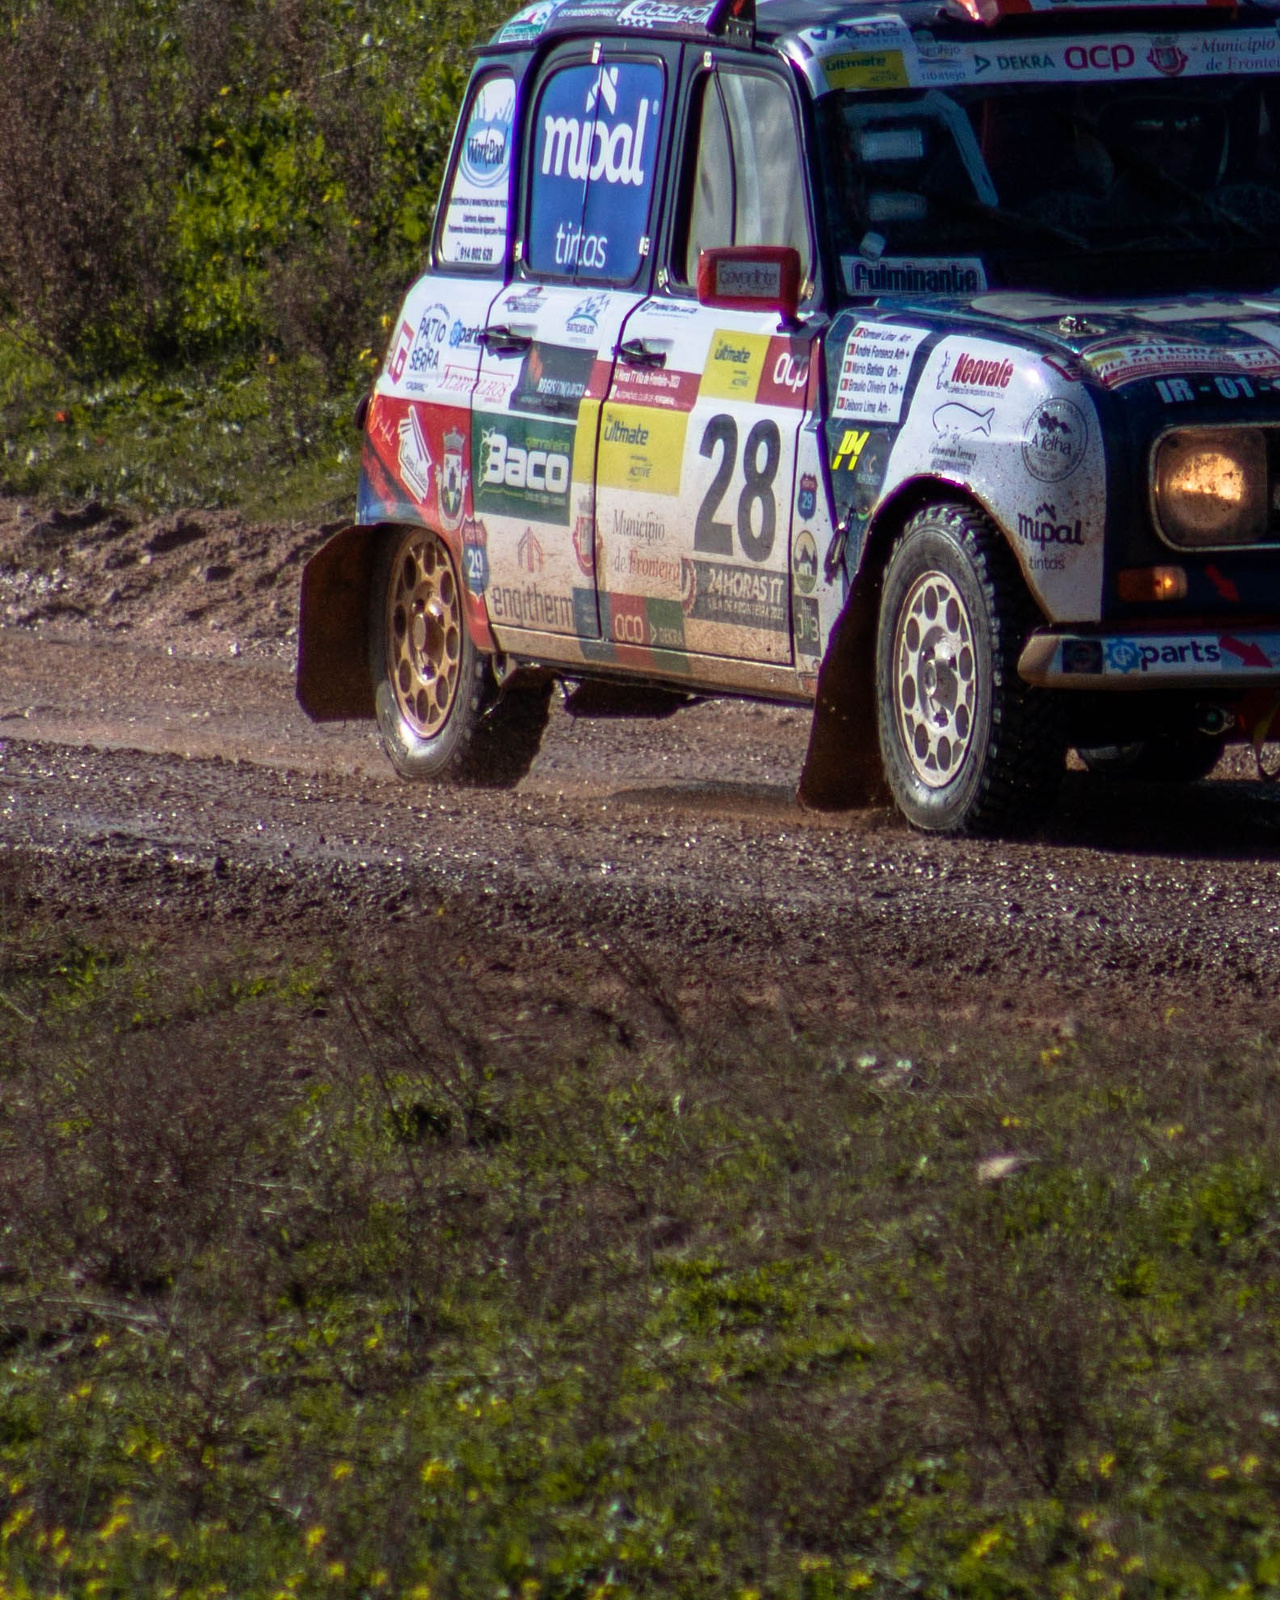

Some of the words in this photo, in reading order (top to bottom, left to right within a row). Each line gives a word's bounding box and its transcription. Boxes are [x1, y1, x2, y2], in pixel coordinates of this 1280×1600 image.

[825, 54, 887, 72] ultimate
[996, 55, 1055, 71] DEKRA
[1064, 44, 1136, 73] acp
[1206, 56, 1224, 71] de
[714, 346, 751, 364] ultimate
[871, 346, 895, 359] Fonseca
[773, 352, 808, 393] acp
[951, 352, 1014, 389] Neovale
[603, 421, 649, 446] ultimate
[1040, 431, 1072, 456] Telha
[484, 433, 570, 494] Baco
[694, 413, 781, 563] 28
[801, 491, 813, 510] 29
[612, 509, 665, 544] Município
[1018, 512, 1085, 550] mipal
[467, 548, 484, 579] 29
[614, 548, 628, 572] de
[628, 547, 680, 581] Fronteira
[1029, 556, 1066, 571] tintas
[491, 580, 575, 628] engitherm
[769, 577, 785, 605] TT
[1140, 640, 1221, 672] parts
